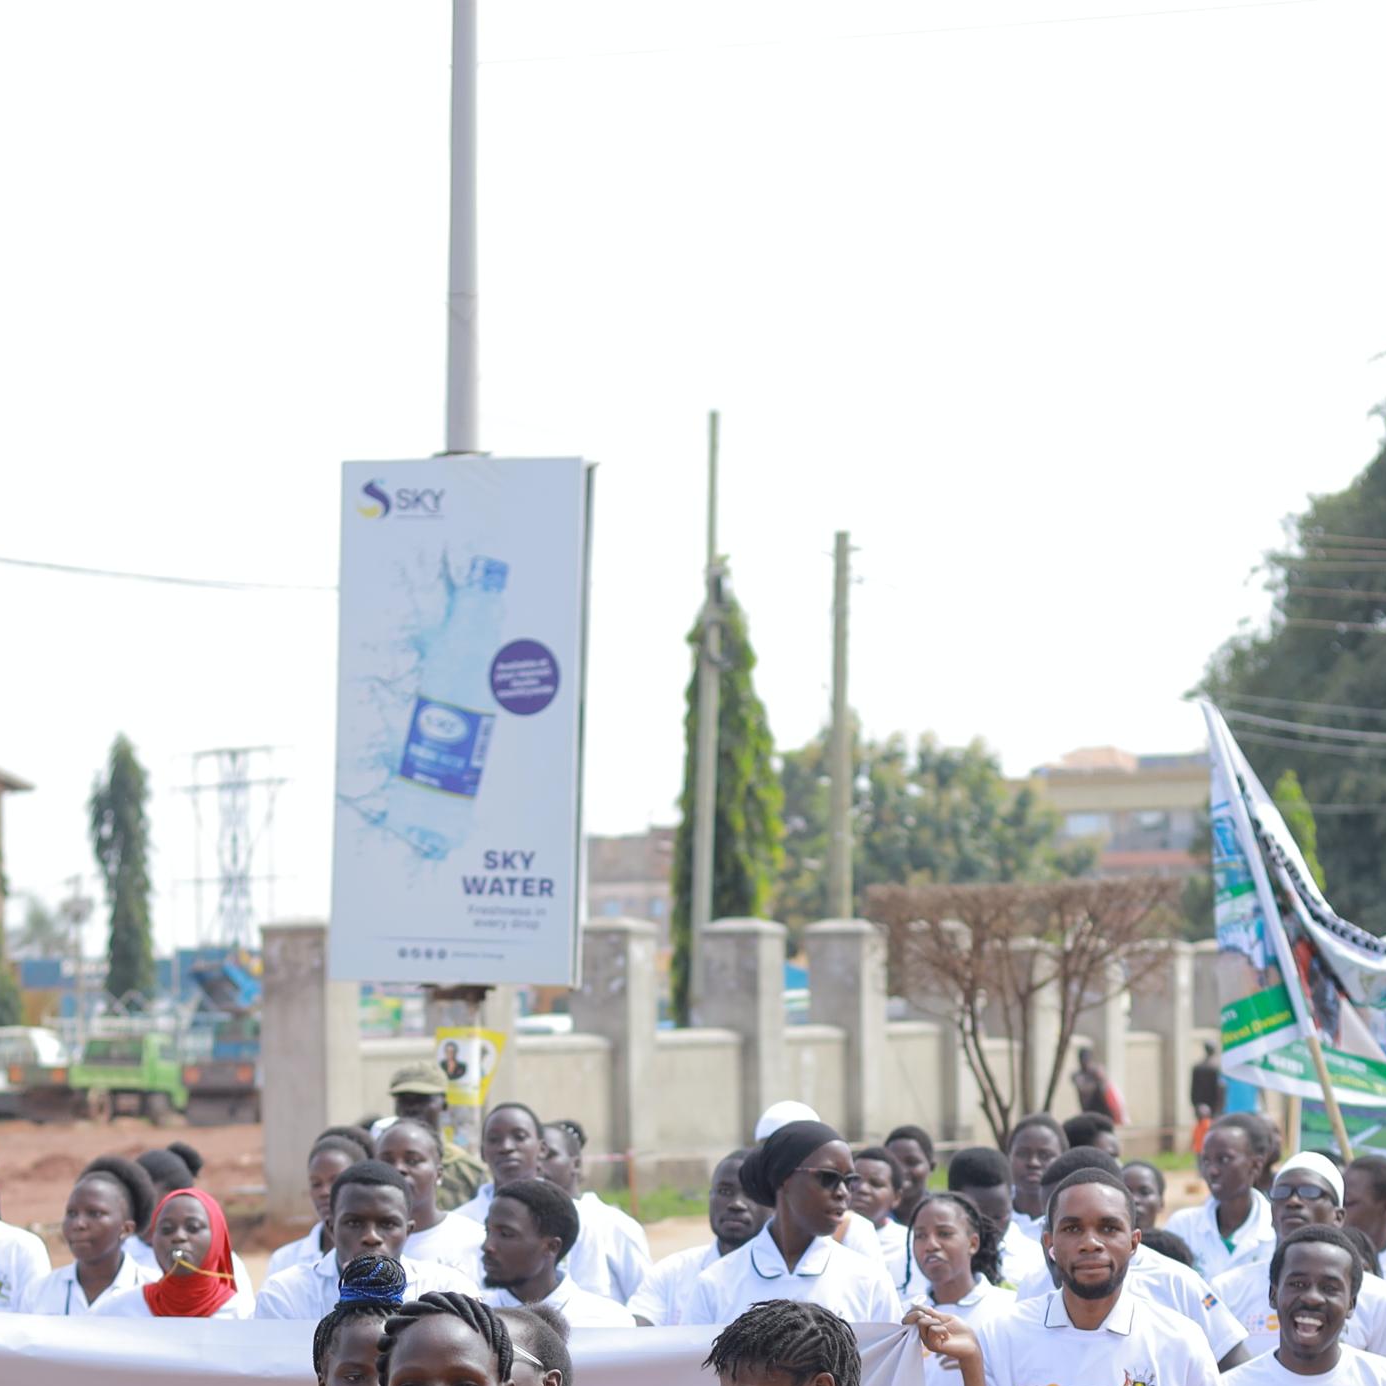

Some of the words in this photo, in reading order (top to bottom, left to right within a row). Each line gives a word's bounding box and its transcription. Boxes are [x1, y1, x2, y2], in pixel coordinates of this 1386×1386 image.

[396, 487, 446, 514] SKY
[484, 849, 535, 871] SKY
[461, 876, 555, 898] WATER
